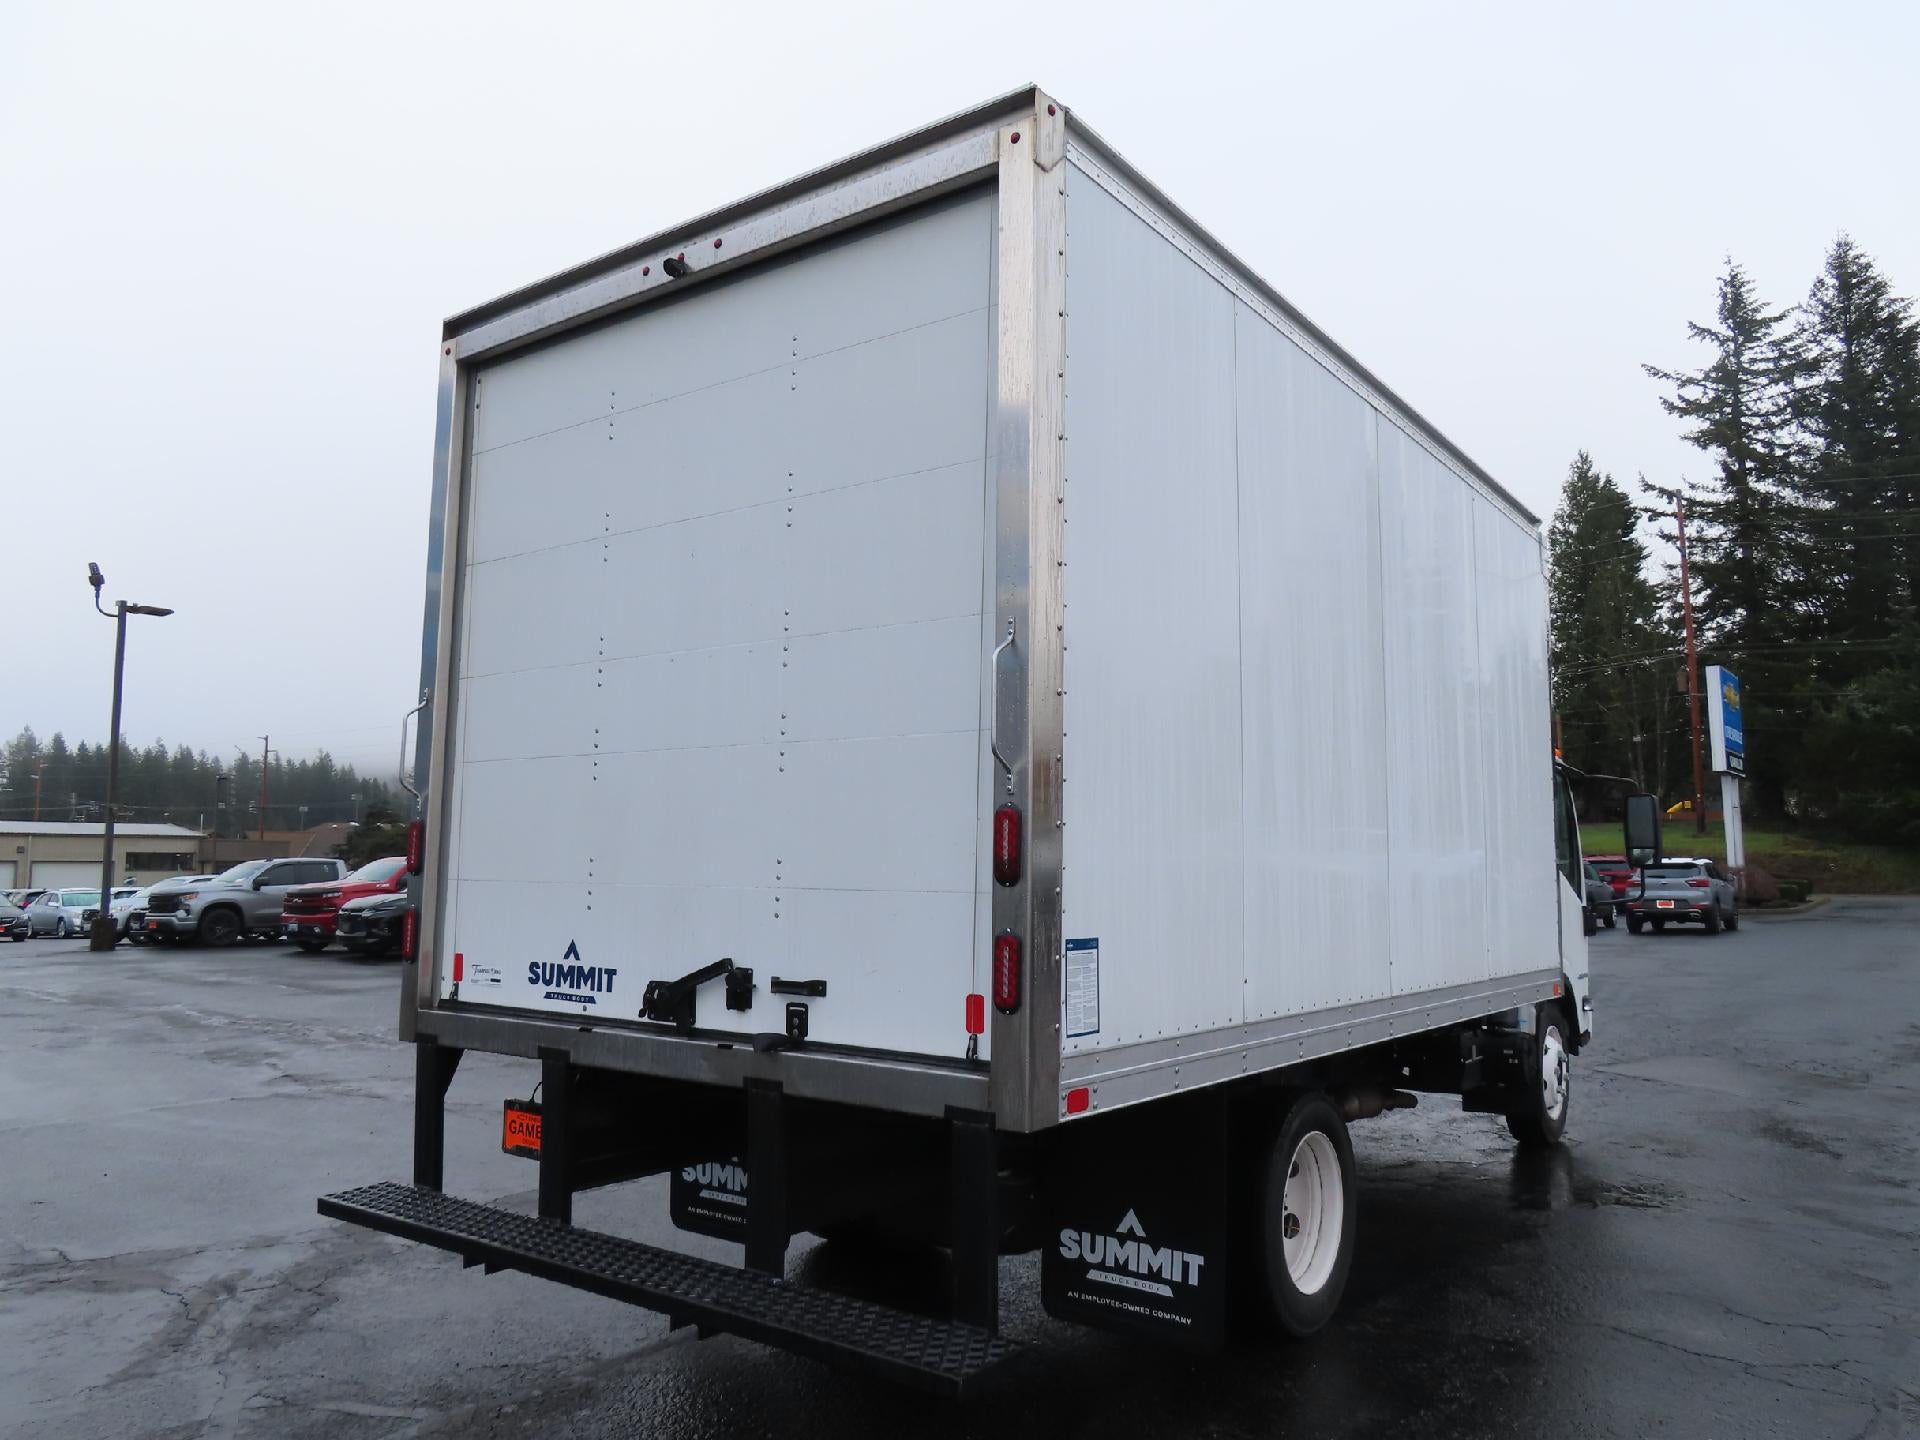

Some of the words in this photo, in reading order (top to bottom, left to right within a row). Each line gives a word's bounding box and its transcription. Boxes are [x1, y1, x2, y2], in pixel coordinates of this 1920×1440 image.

[528, 961, 617, 993] SUMMIT
[682, 1160, 748, 1192] SUMM
[1059, 1228, 1204, 1287] SUMMIT
[1098, 1272, 1130, 1286] TRUCK
[1067, 1290, 1079, 1299] AN
[1081, 1292, 1150, 1315] EMPLOYEE-OWNED
[1152, 1309, 1192, 1325] COMPANY
